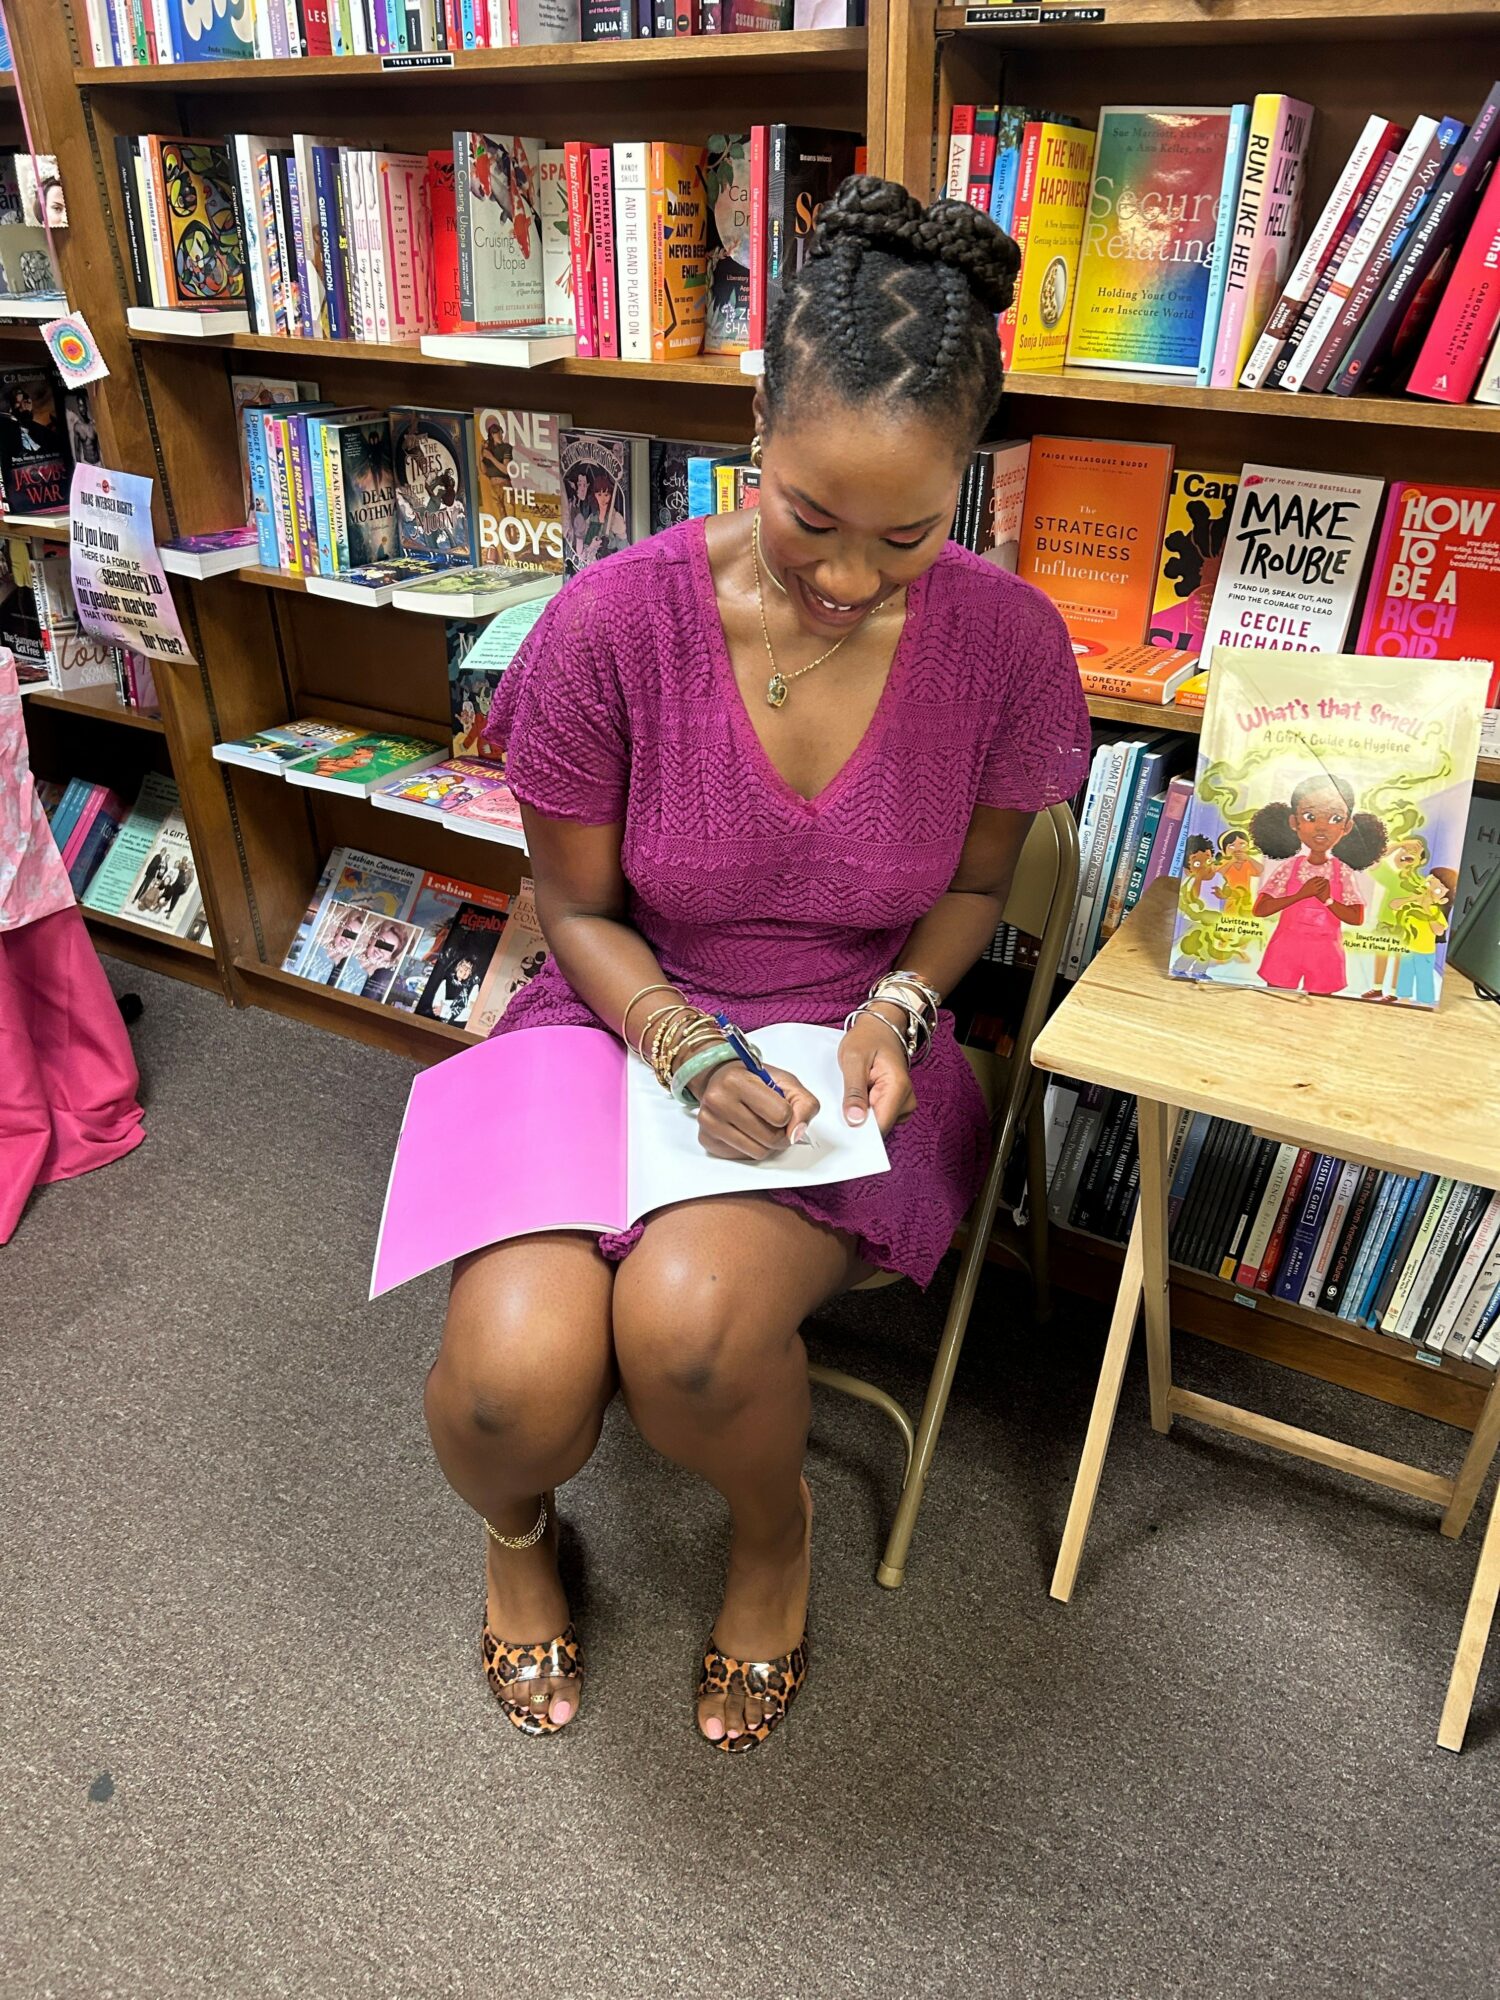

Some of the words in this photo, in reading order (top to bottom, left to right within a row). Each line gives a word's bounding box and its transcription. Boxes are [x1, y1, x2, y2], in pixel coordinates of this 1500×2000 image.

[593, 21, 618, 33] JULIA
[735, 13, 754, 26] SUSAN
[975, 9, 1033, 20] PSYCHOLOGY
[1043, 11, 1067, 20] SELF
[1074, 10, 1099, 19] HELP
[416, 57, 444, 66] STUDIES
[1112, 127, 1129, 137] Sue
[1281, 113, 1307, 155] RUN
[1027, 136, 1037, 157] Sonja
[1046, 138, 1065, 167] THE
[1068, 142, 1087, 170] HOW
[1245, 134, 1270, 184] RUN
[1272, 157, 1299, 197] LIKE
[1418, 159, 1441, 183] My
[678, 180, 691, 195] THE
[1038, 177, 1088, 209] HAPPINESS
[289, 190, 301, 227] FAMILY
[318, 196, 328, 229] QUEER
[593, 192, 603, 249] DETENTION
[602, 183, 610, 230] WOMEN'S
[624, 196, 636, 219] AND
[667, 201, 699, 217] RAINBOW
[1237, 187, 1261, 239] LIKE
[1416, 190, 1454, 243] Tending
[474, 226, 516, 254] Cruising
[625, 223, 637, 242] THE
[676, 224, 693, 238] AIN'T
[1372, 183, 1427, 287] Grandmother's
[320, 229, 335, 292] CONCEPTION
[604, 232, 612, 264] HOUSE
[668, 245, 693, 259] NEVER
[1083, 223, 1218, 270] Relating
[494, 249, 526, 275] Utopia
[626, 246, 638, 276] BAND
[682, 265, 699, 280] ENUF
[1227, 242, 1251, 293] HELL
[1097, 287, 1138, 301] Holding
[1140, 287, 1165, 301] Your
[1167, 291, 1192, 302] Own
[1387, 264, 1415, 302] Bones
[627, 279, 640, 318] PLAYED
[1090, 305, 1101, 314] in
[1103, 306, 1114, 314] an
[1116, 304, 1159, 317] Insecure
[1163, 306, 1195, 320] World
[1305, 286, 1328, 316] FROM
[1342, 284, 1372, 327] Hands
[628, 319, 640, 335] ON
[1289, 315, 1313, 348] HERE
[479, 409, 553, 451] ONE
[506, 460, 530, 480] OF
[1041, 452, 1066, 462] PAIGE
[279, 464, 289, 506] LOVER
[332, 463, 341, 492] DEAR
[1277, 479, 1296, 487] YORK
[1297, 481, 1318, 489] TIMES
[1319, 483, 1362, 495] BESTSELLER
[26, 482, 64, 504] WAR
[362, 487, 394, 505] DEAR
[503, 486, 536, 507] THE
[336, 494, 345, 545] MOTHMAN
[1079, 505, 1097, 515] The
[1240, 491, 1361, 543] MAKE
[1403, 495, 1496, 537] HOW
[73, 520, 84, 542] Did
[85, 527, 98, 549] you
[99, 526, 120, 552] know
[283, 508, 294, 543] BIRDS
[479, 513, 564, 559] BOYS
[1033, 516, 1139, 542] STRATEGIC
[81, 549, 99, 563] THERE
[99, 553, 105, 564] IS
[112, 556, 131, 569] FORM
[132, 561, 141, 572] OF
[1036, 537, 1131, 562] BUSINESS
[1235, 528, 1352, 585] TROUBLE
[1399, 529, 1440, 567] TO
[504, 558, 544, 572] VICTORIA
[1033, 557, 1130, 586] Influencer
[75, 576, 92, 589] WITH
[102, 567, 150, 596] secondary
[150, 574, 163, 594] ID
[1233, 582, 1258, 593] STAND
[1259, 587, 1270, 596] UP,
[1272, 588, 1296, 600] SPEAK
[1298, 592, 1315, 604] OUT,
[1316, 595, 1333, 605] AND
[1387, 563, 1432, 601] BE
[1433, 570, 1457, 605] A
[90, 591, 121, 612] gender
[123, 597, 158, 619] marker
[1228, 592, 1246, 603] FIND
[1248, 595, 1262, 604] THE
[1263, 598, 1300, 611] COURAGE
[1301, 603, 1311, 612] TO
[1312, 605, 1333, 616] LEAD
[83, 608, 101, 620] THAT
[102, 612, 118, 624] YOU
[118, 615, 133, 627] CAN
[135, 618, 149, 629] GET
[1240, 610, 1312, 638] CECILE
[1380, 599, 1458, 639] RICH
[3, 631, 14, 642] The
[13, 634, 40, 647] Summer
[157, 632, 185, 656] free?
[1086, 674, 1132, 688] LORETTA
[1101, 685, 1128, 694] ROSS
[284, 725, 343, 742] QUEER
[297, 721, 356, 738] GENDER
[1236, 698, 1310, 733] What's
[1317, 697, 1361, 722] that
[1369, 704, 1444, 747] Smell?
[1263, 730, 1272, 743] A
[1276, 729, 1307, 744] Girl's
[1310, 734, 1345, 748] Guide
[1349, 735, 1361, 748] to
[1364, 738, 1411, 753] Hygiene
[1109, 753, 1123, 796] SOMATIC
[171, 830, 185, 841] GIFT
[1094, 794, 1115, 867] PSYCHOTHERAPY
[1123, 802, 1142, 851] Self-Compassion
[1137, 831, 1153, 864] SUBTLE
[348, 852, 375, 867] Lesbian
[376, 861, 416, 878] Connection
[426, 876, 473, 899] Lesbian
[1085, 865, 1098, 894] TOOLBOX
[1215, 924, 1236, 934] Imani
[1221, 917, 1250, 927] Written
[1251, 921, 1260, 929] by
[1104, 1123, 1120, 1157] WARRIOR
[1271, 1164, 1288, 1207] PATIENCE
[1338, 1178, 1353, 1206] Girls
[1306, 1196, 1321, 1225] GIRLS
[1430, 1211, 1452, 1255] TRAFFICKING
[1332, 1255, 1347, 1283] Cultures
